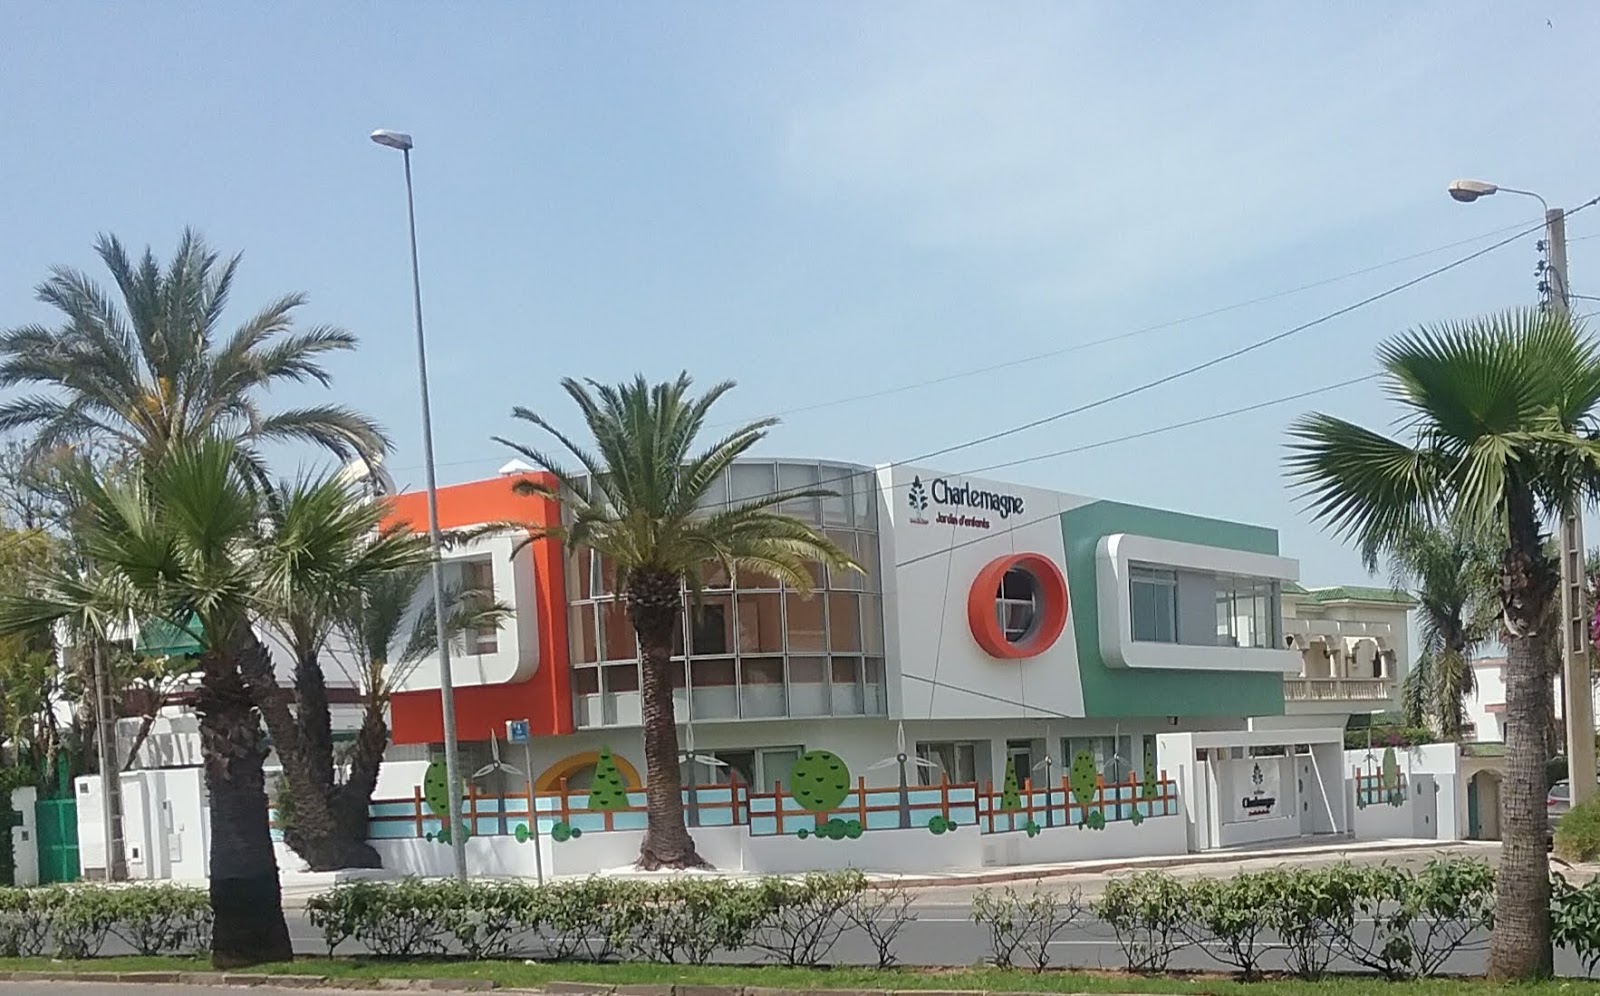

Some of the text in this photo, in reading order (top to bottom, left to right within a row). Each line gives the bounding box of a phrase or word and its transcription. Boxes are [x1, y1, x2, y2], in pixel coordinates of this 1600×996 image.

[931, 478, 1024, 519] Charlemagne
[936, 512, 958, 526] Jardin
[959, 515, 990, 529] d'enfants
